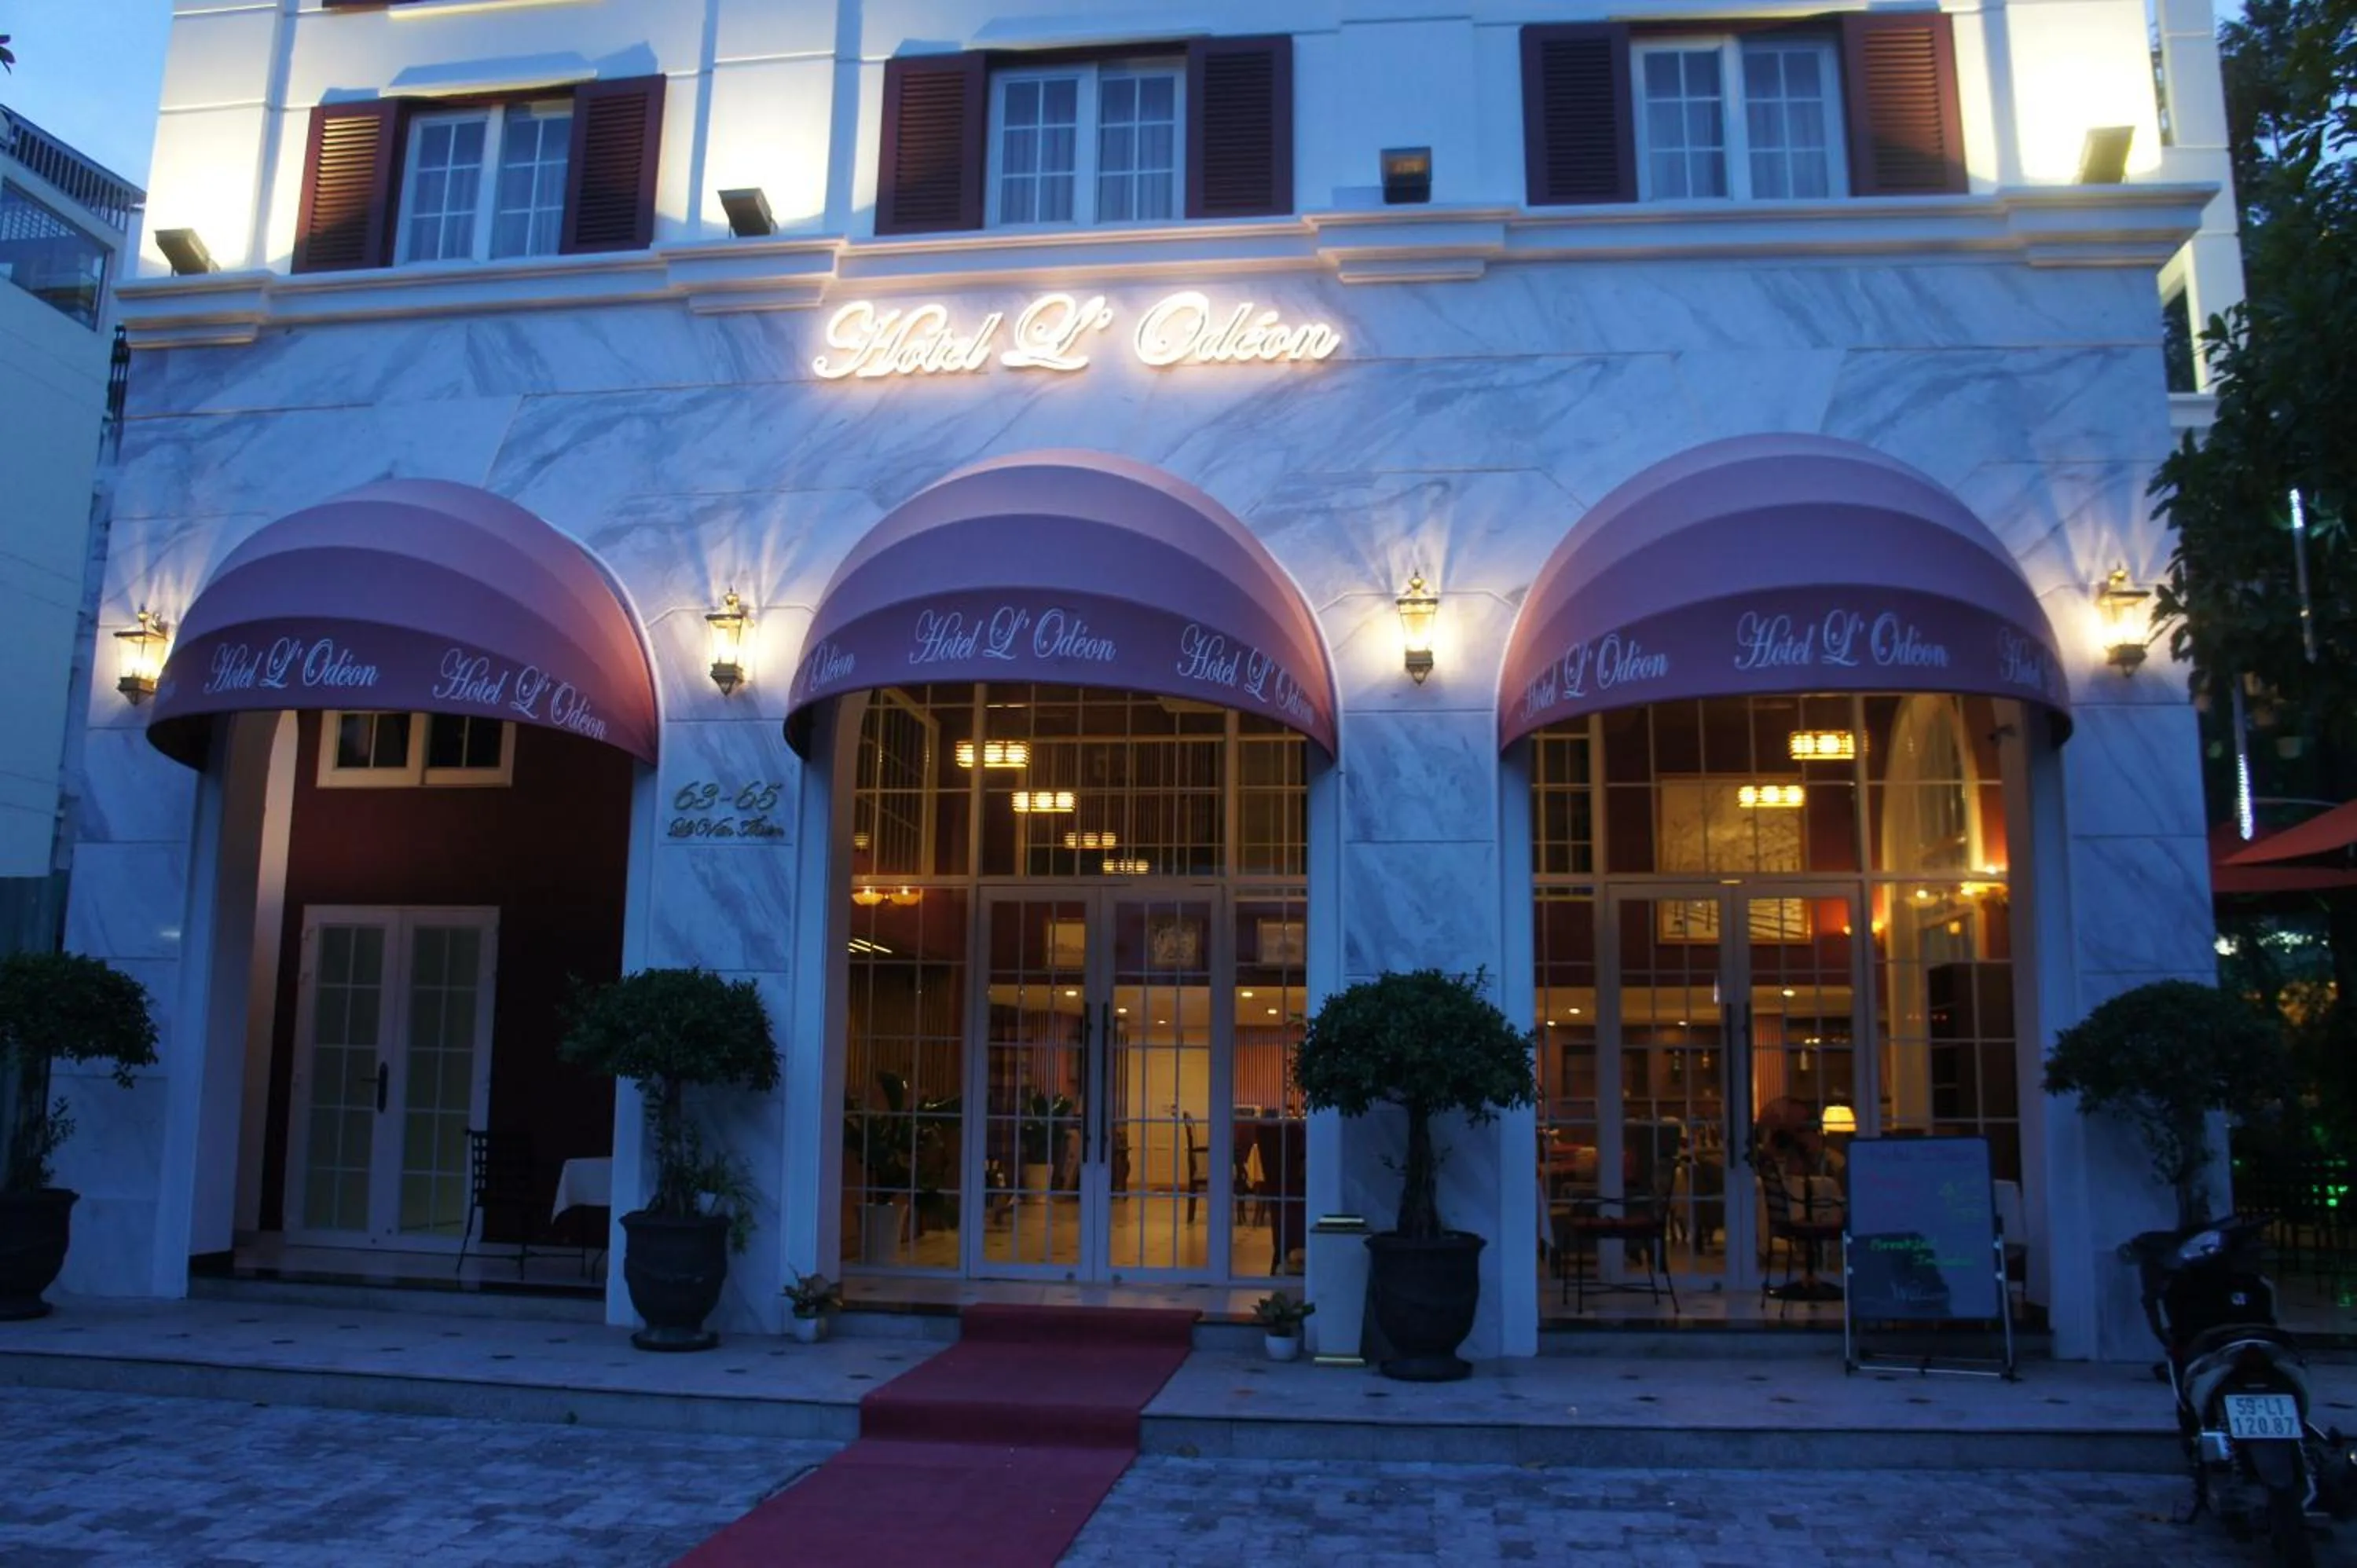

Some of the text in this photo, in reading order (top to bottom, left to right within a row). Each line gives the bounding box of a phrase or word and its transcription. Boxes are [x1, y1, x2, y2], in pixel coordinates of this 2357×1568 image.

[812, 300, 1004, 379] Hotel
[1134, 291, 1340, 365] Odéon
[302, 638, 379, 687] Odéon
[909, 609, 984, 665] Hotel
[1033, 608, 1116, 661] Odéon
[1177, 624, 1241, 687] Hotel
[1596, 633, 1670, 690] Odéon
[1734, 610, 1816, 670] Hotel
[1871, 612, 1949, 666] Odéon
[432, 648, 509, 705] Hotel
[550, 682, 607, 742] Odéon
